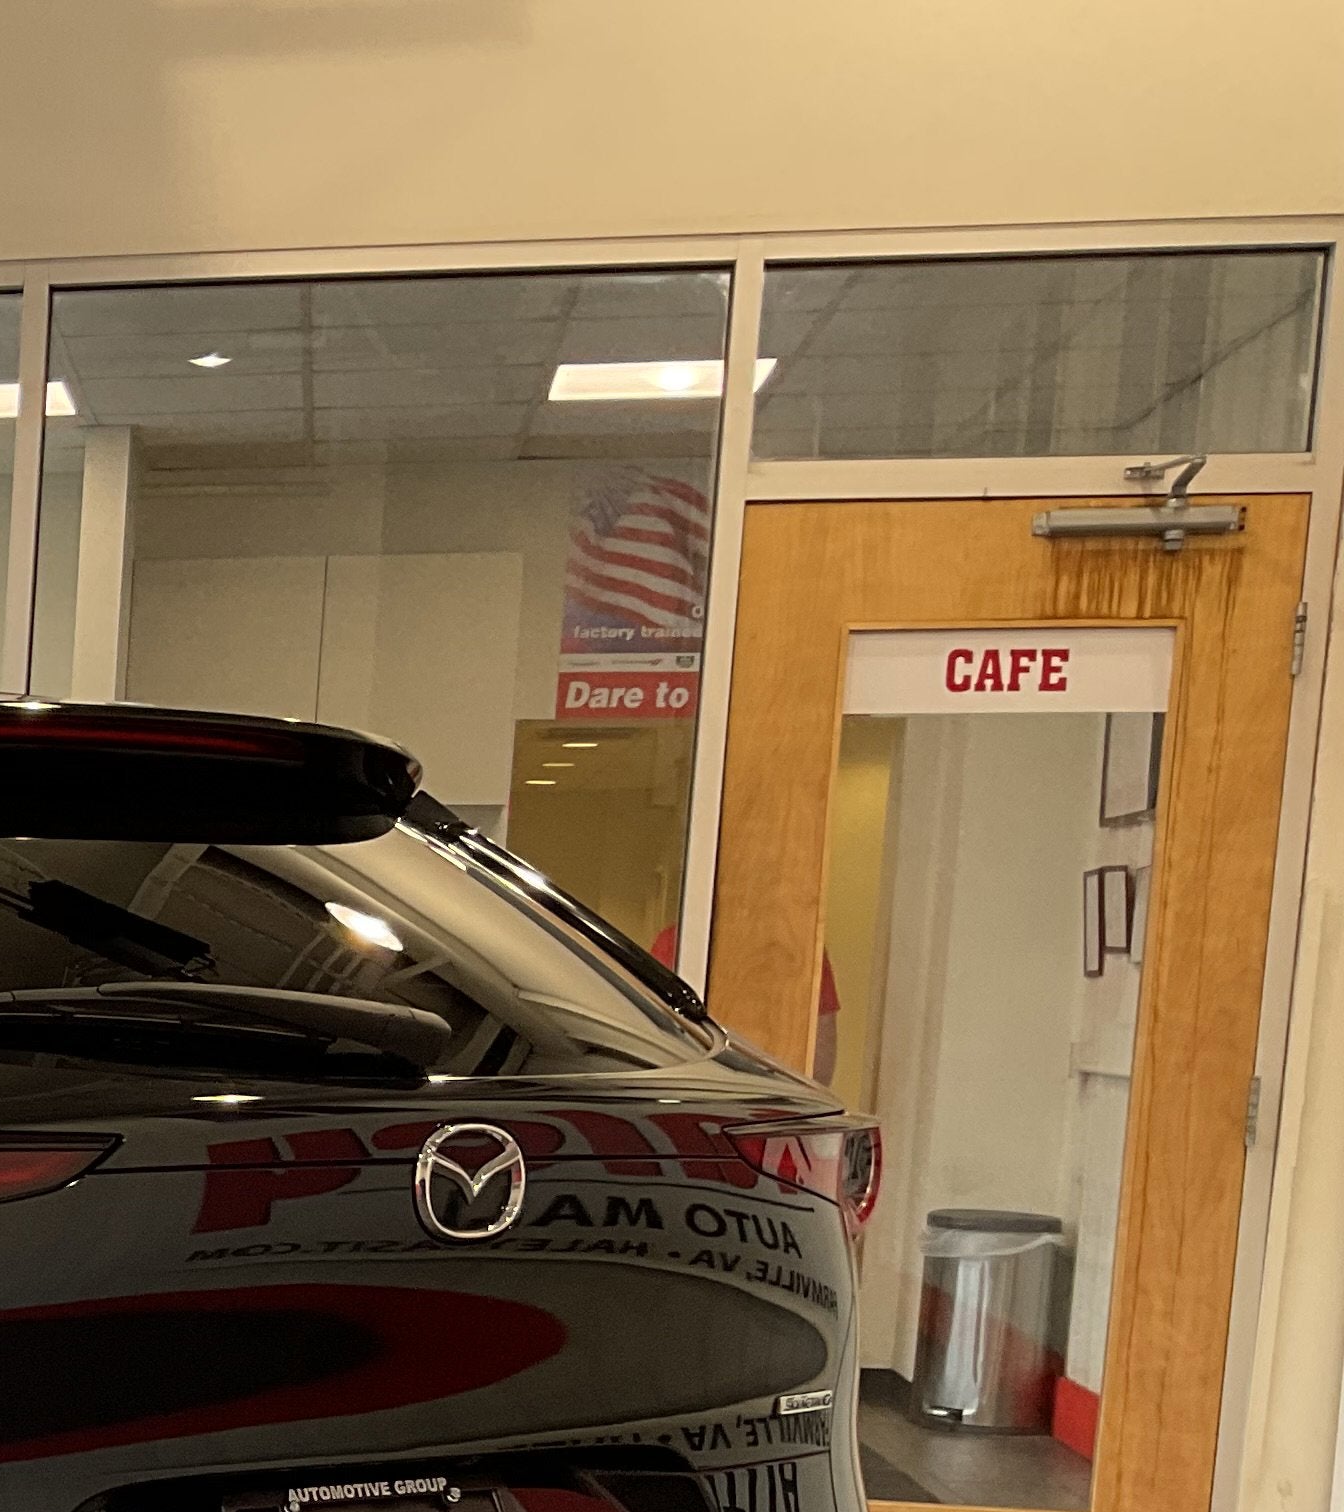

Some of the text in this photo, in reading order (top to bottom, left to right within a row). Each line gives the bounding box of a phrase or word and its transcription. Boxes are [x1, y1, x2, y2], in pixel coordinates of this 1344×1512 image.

[946, 648, 1070, 693] CAFE
[565, 681, 689, 709] Dare to
[288, 1476, 448, 1503] AUTOMOTIVE GROUP
